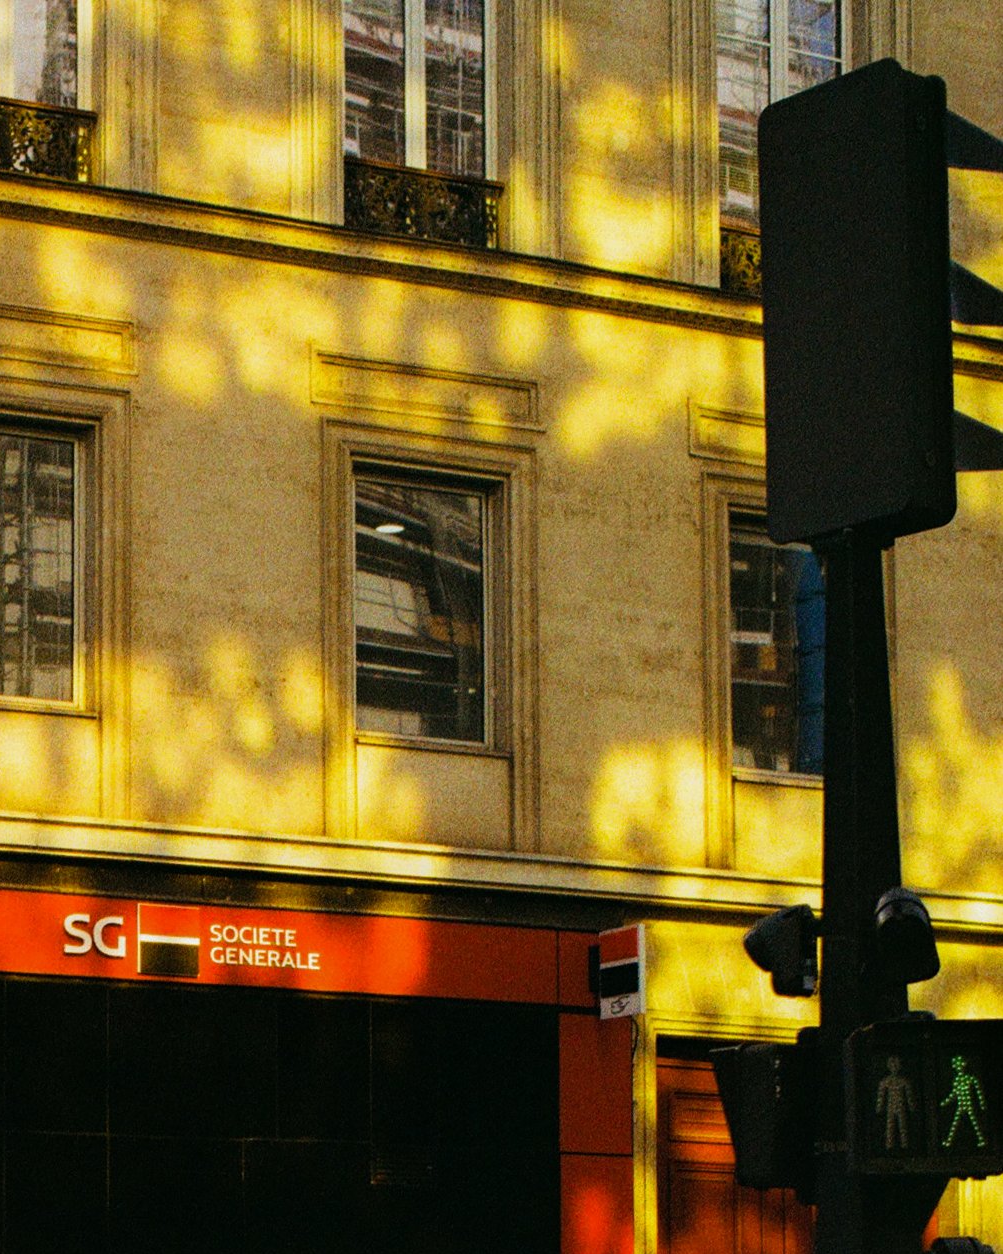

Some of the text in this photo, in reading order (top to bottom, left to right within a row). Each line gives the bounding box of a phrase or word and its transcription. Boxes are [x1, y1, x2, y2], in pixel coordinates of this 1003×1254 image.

[63, 913, 127, 958] SG
[209, 924, 297, 948] SOCIETE
[209, 946, 321, 971] GENERALE
